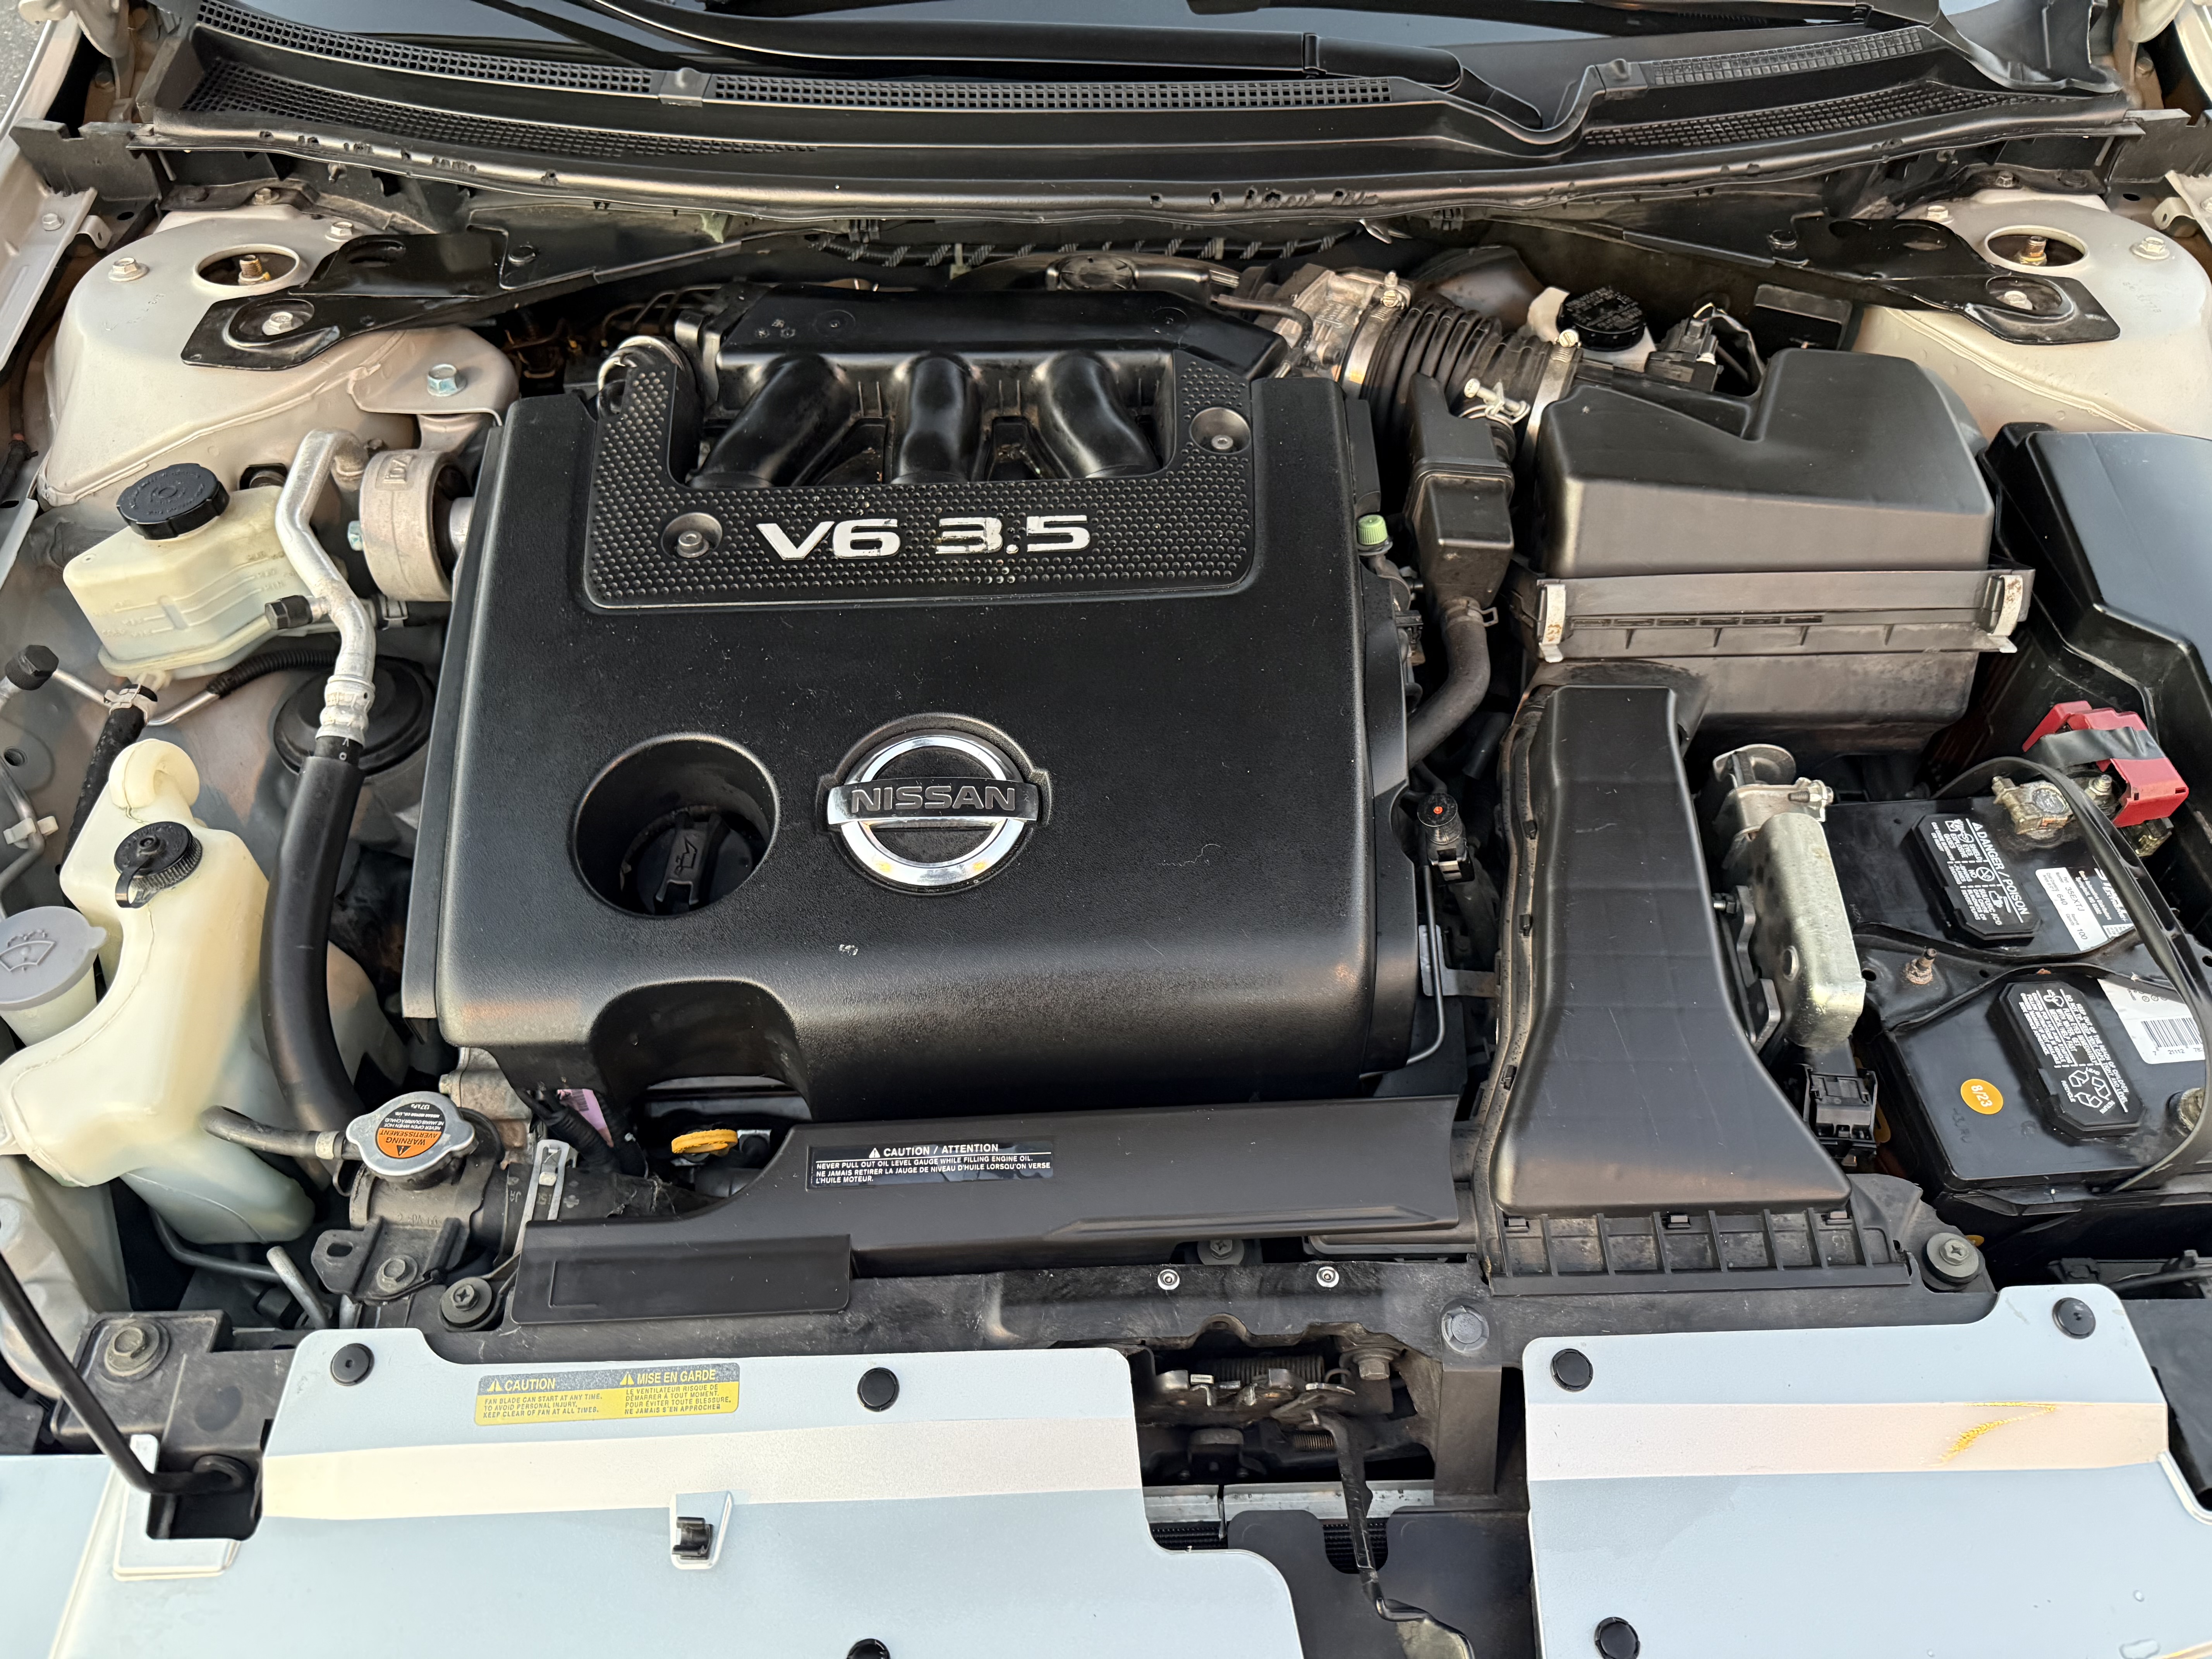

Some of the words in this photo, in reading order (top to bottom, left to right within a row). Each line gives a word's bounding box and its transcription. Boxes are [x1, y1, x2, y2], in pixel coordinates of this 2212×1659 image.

[756, 518, 901, 560] V6
[936, 514, 1091, 555] 3.5
[851, 786, 1015, 812] NISSAN
[1968, 844, 1983, 860] SHIELD
[1976, 832, 2005, 869] DANGER
[2002, 879, 2030, 914] POISON
[1978, 889, 1996, 912] SULFURIC
[1990, 913, 2002, 924] ACID
[2057, 894, 2068, 905] 640
[2065, 887, 2085, 911] 35EXTJ
[2076, 929, 2088, 939] 100
[1971, 1085, 1992, 1106] 8/23
[379, 1130, 438, 1138] AVERTISSEMENT
[385, 1137, 425, 1145] WARNING
[884, 1146, 930, 1157] CAUTION
[933, 1146, 938, 1155] /
[942, 1144, 998, 1154] ATTENTION
[637, 1372, 660, 1384] MISE
[664, 1371, 677, 1383] EN
[680, 1369, 716, 1382] GARDE
[505, 1378, 555, 1391] CAUTION
[626, 1393, 661, 1401] DÉMARRER
